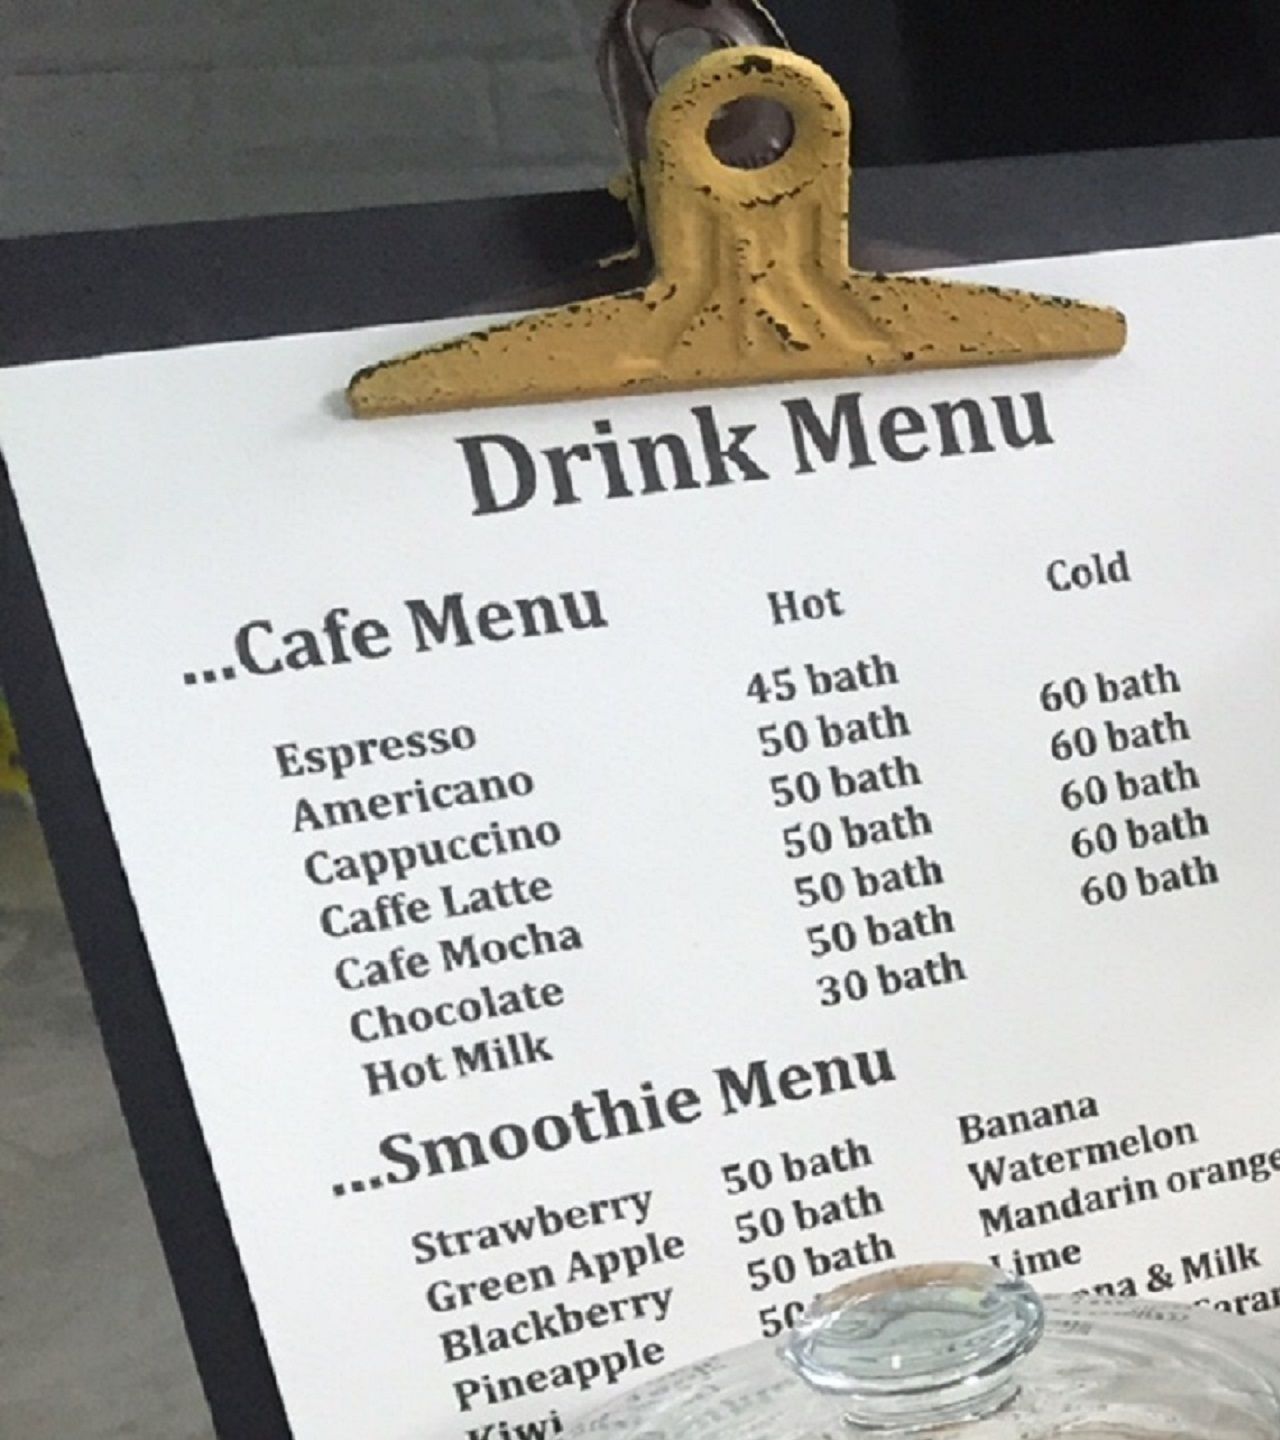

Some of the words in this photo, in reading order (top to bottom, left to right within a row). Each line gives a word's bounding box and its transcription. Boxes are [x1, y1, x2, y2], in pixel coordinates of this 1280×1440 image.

[455, 404, 770, 516] Drink
[782, 391, 1054, 475] Menu
[1047, 550, 1130, 591] Cold
[404, 590, 608, 652] Menu
[767, 588, 844, 625] Hot
[747, 667, 796, 703] 45
[804, 654, 899, 696] bath
[1040, 677, 1087, 712] 60
[1095, 664, 1181, 703] bath
[274, 725, 476, 780] Espresso
[758, 720, 809, 757] 50
[816, 705, 911, 748] bath
[1051, 727, 1097, 760] 60
[1104, 711, 1190, 752] bath
[295, 772, 534, 832] Americano
[770, 771, 821, 807] 50
[828, 756, 922, 797] bath
[1061, 776, 1107, 811] 60
[1115, 760, 1200, 801] bath
[305, 821, 560, 886] Cappuccino
[783, 822, 832, 858] 50
[840, 805, 932, 848] bath
[1072, 823, 1117, 859] 60
[1125, 807, 1209, 849] bath
[320, 892, 431, 937] Caffe
[440, 877, 552, 917] Latte
[795, 872, 845, 907] 50
[852, 855, 944, 897] bath
[1081, 872, 1127, 905] 60
[1135, 856, 1219, 896] bath
[335, 946, 430, 990] Cafe
[438, 923, 582, 971] Mocha
[807, 922, 857, 957] 50
[864, 904, 955, 946] bath
[817, 970, 868, 1006] 30
[876, 952, 967, 996] bath
[351, 983, 564, 1043] Chocolate
[362, 1053, 447, 1096] Hot
[452, 1032, 553, 1077] Milk
[713, 1048, 896, 1116] Menu
[958, 1097, 1099, 1144] Banana
[721, 1159, 772, 1195] 50
[780, 1138, 872, 1182] bath
[968, 1123, 1198, 1191] Watermelon
[412, 1191, 652, 1264] Strawberry
[735, 1208, 784, 1244] 50
[792, 1185, 884, 1231] bath
[979, 1176, 1159, 1237] Mandarin
[427, 1265, 556, 1312] Green
[568, 1233, 684, 1284] Apple
[747, 1255, 796, 1291] 50
[803, 1233, 895, 1276] bath
[1147, 1263, 1175, 1293] &
[1181, 1243, 1261, 1284] Milk
[440, 1288, 672, 1363] Blackberry
[453, 1339, 664, 1412] Pineapple
